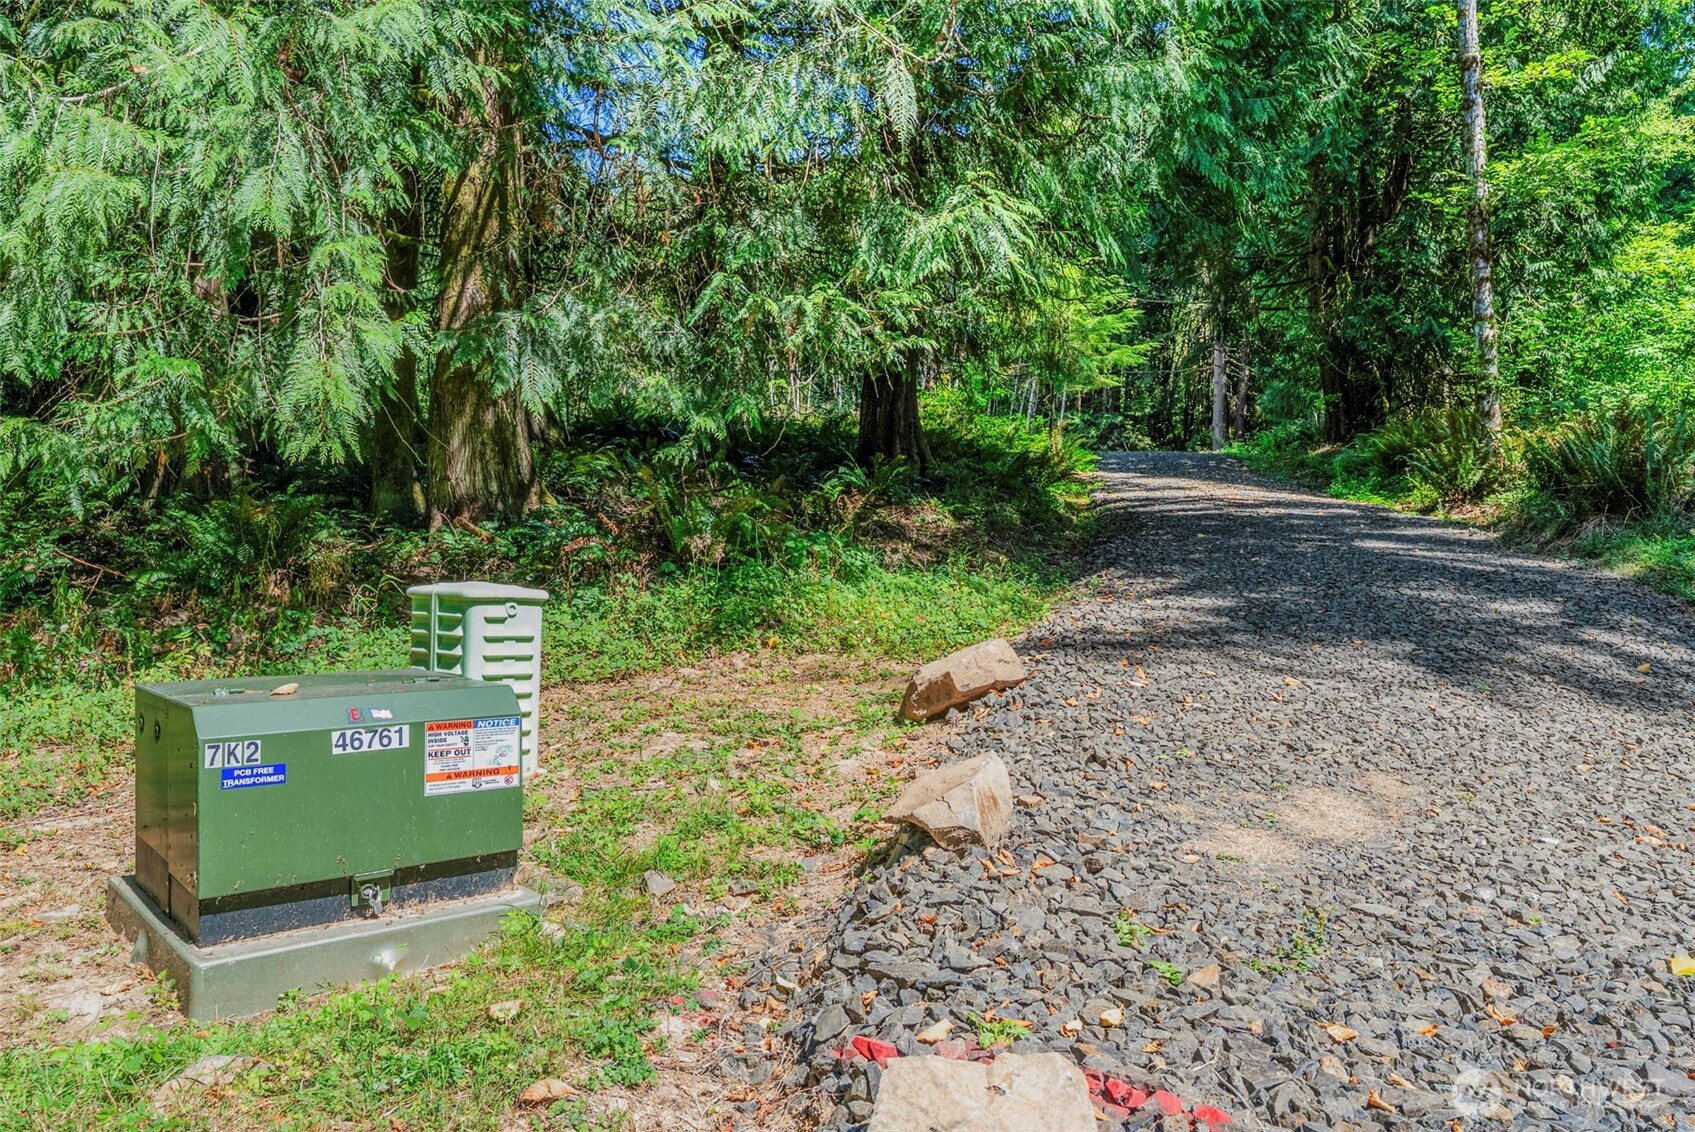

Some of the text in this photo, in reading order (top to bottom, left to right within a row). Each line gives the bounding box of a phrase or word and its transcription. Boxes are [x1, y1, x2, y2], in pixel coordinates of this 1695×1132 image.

[435, 721, 472, 730] WARNING
[477, 718, 517, 728] NOTICE
[334, 726, 404, 752] 46761
[428, 748, 471, 758] KEEP OUT
[234, 766, 275, 776] PCB FREE
[454, 768, 500, 779] WARNING
[222, 774, 285, 788] TRANSFORMER
